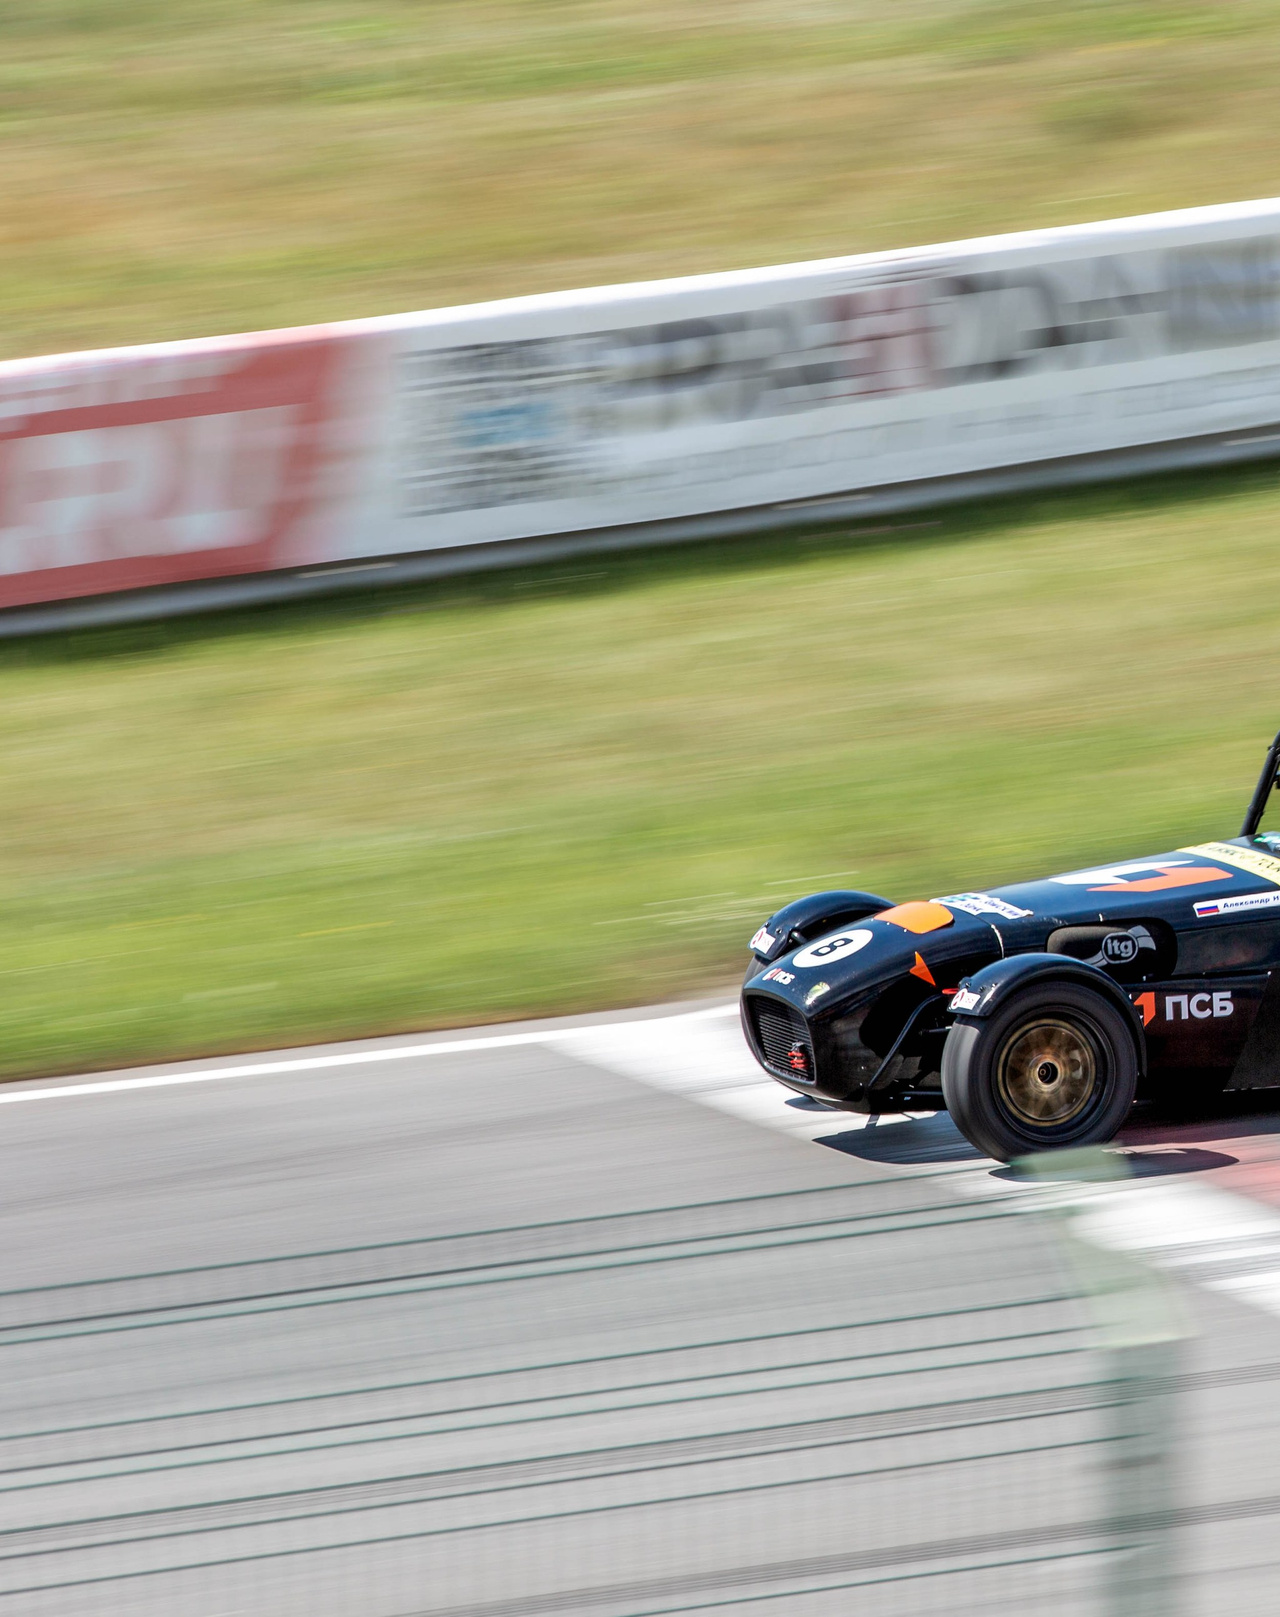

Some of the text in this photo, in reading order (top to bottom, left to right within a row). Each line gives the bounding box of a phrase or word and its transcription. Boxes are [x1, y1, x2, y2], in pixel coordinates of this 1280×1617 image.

[810, 937, 854, 957] 8
[1106, 938, 1133, 959] itg
[1165, 990, 1234, 1021] ПСБ
